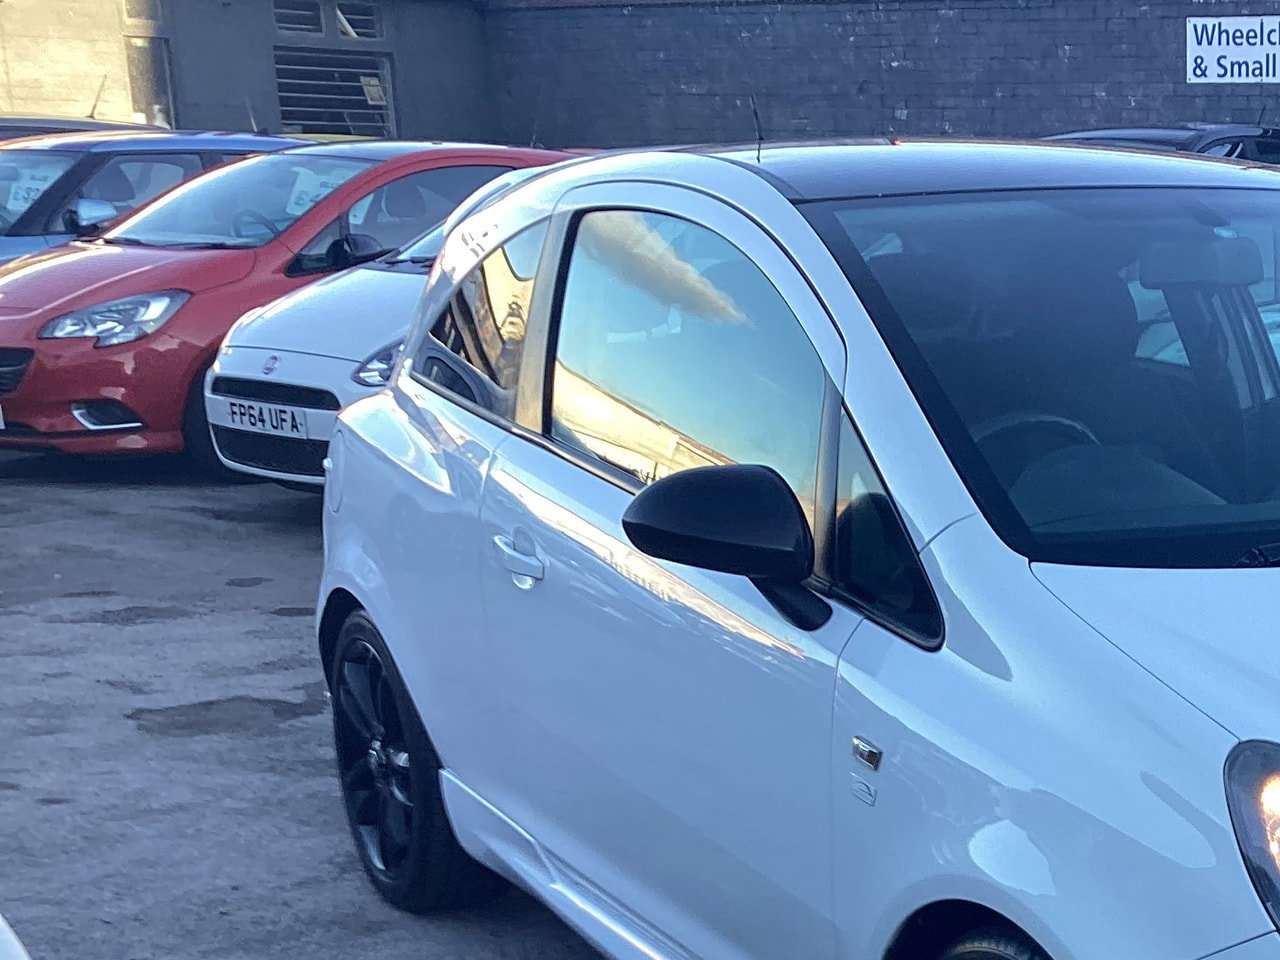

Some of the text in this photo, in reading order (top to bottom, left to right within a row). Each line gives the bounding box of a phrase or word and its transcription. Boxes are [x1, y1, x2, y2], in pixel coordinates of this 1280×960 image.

[1192, 55, 1208, 78] &
[1216, 53, 1277, 78] Small
[229, 402, 300, 432] FP64 UFA
